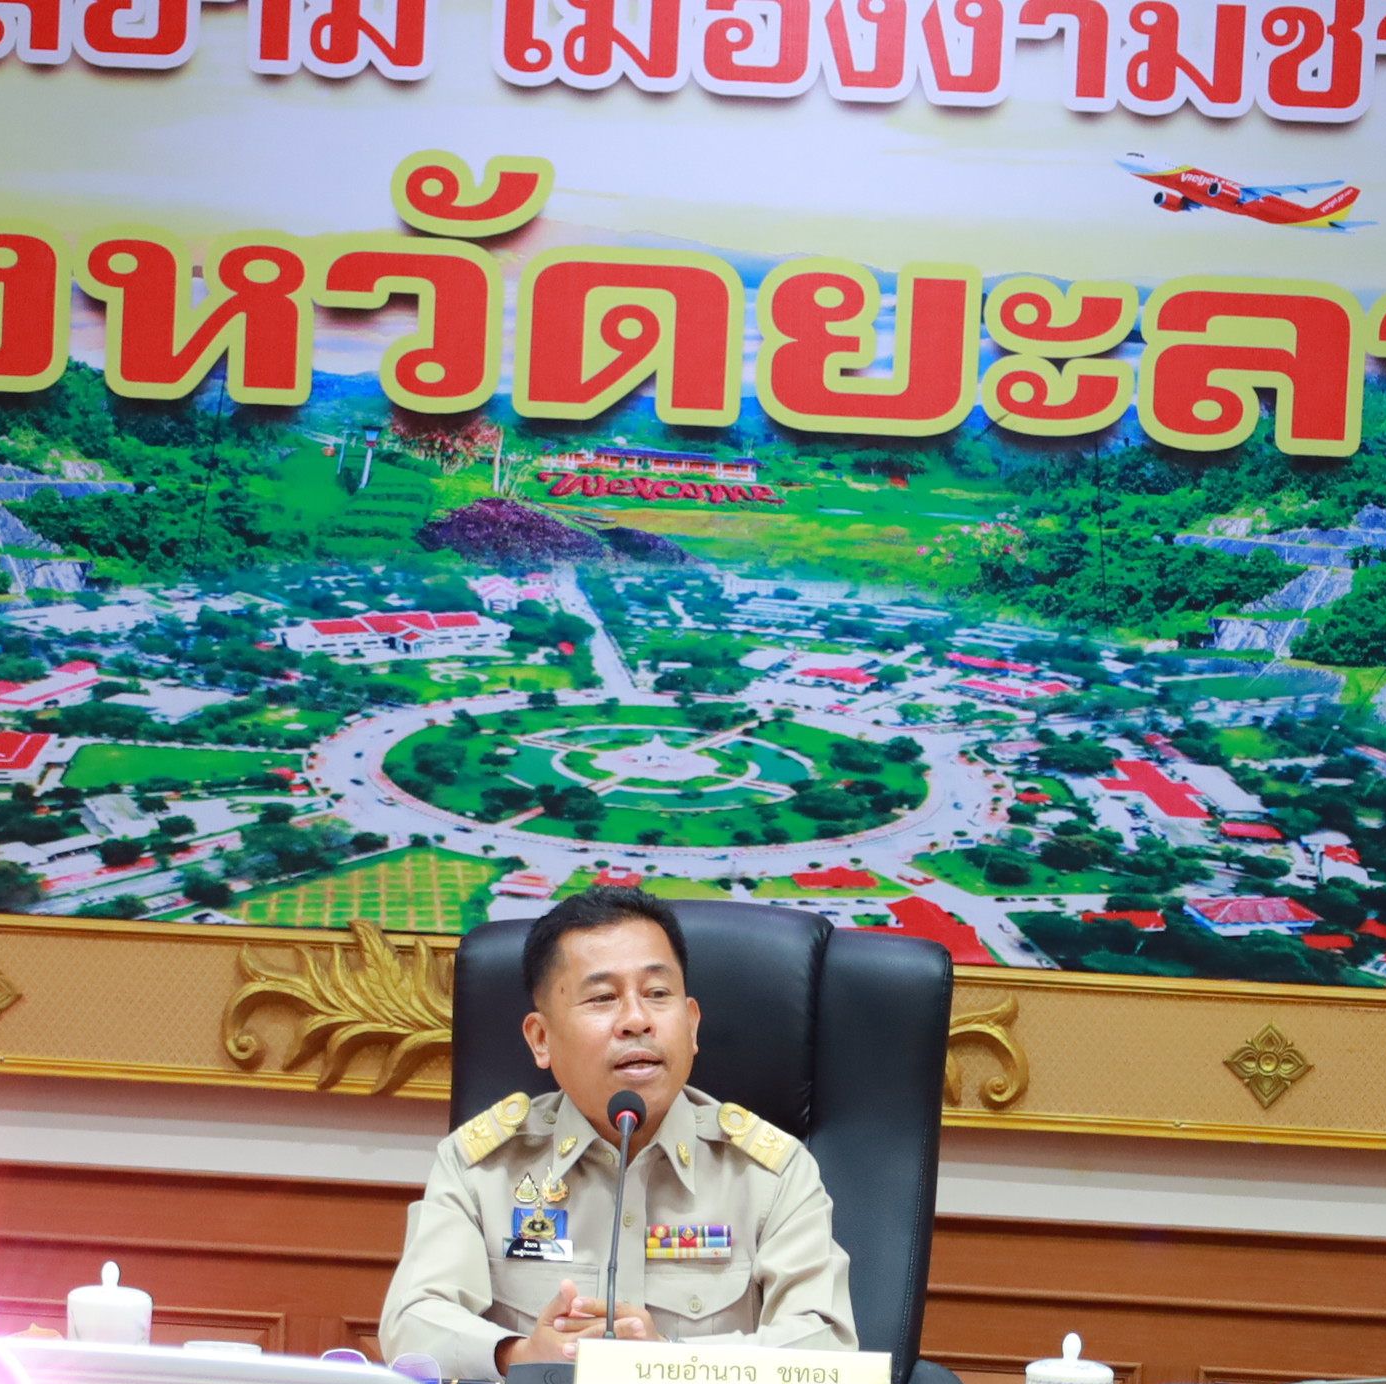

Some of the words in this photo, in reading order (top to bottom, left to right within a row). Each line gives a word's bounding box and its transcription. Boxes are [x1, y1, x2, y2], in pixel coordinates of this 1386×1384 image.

[537, 470, 788, 505] Welcome
[634, 1355, 758, 1384] นายอำนาจ
